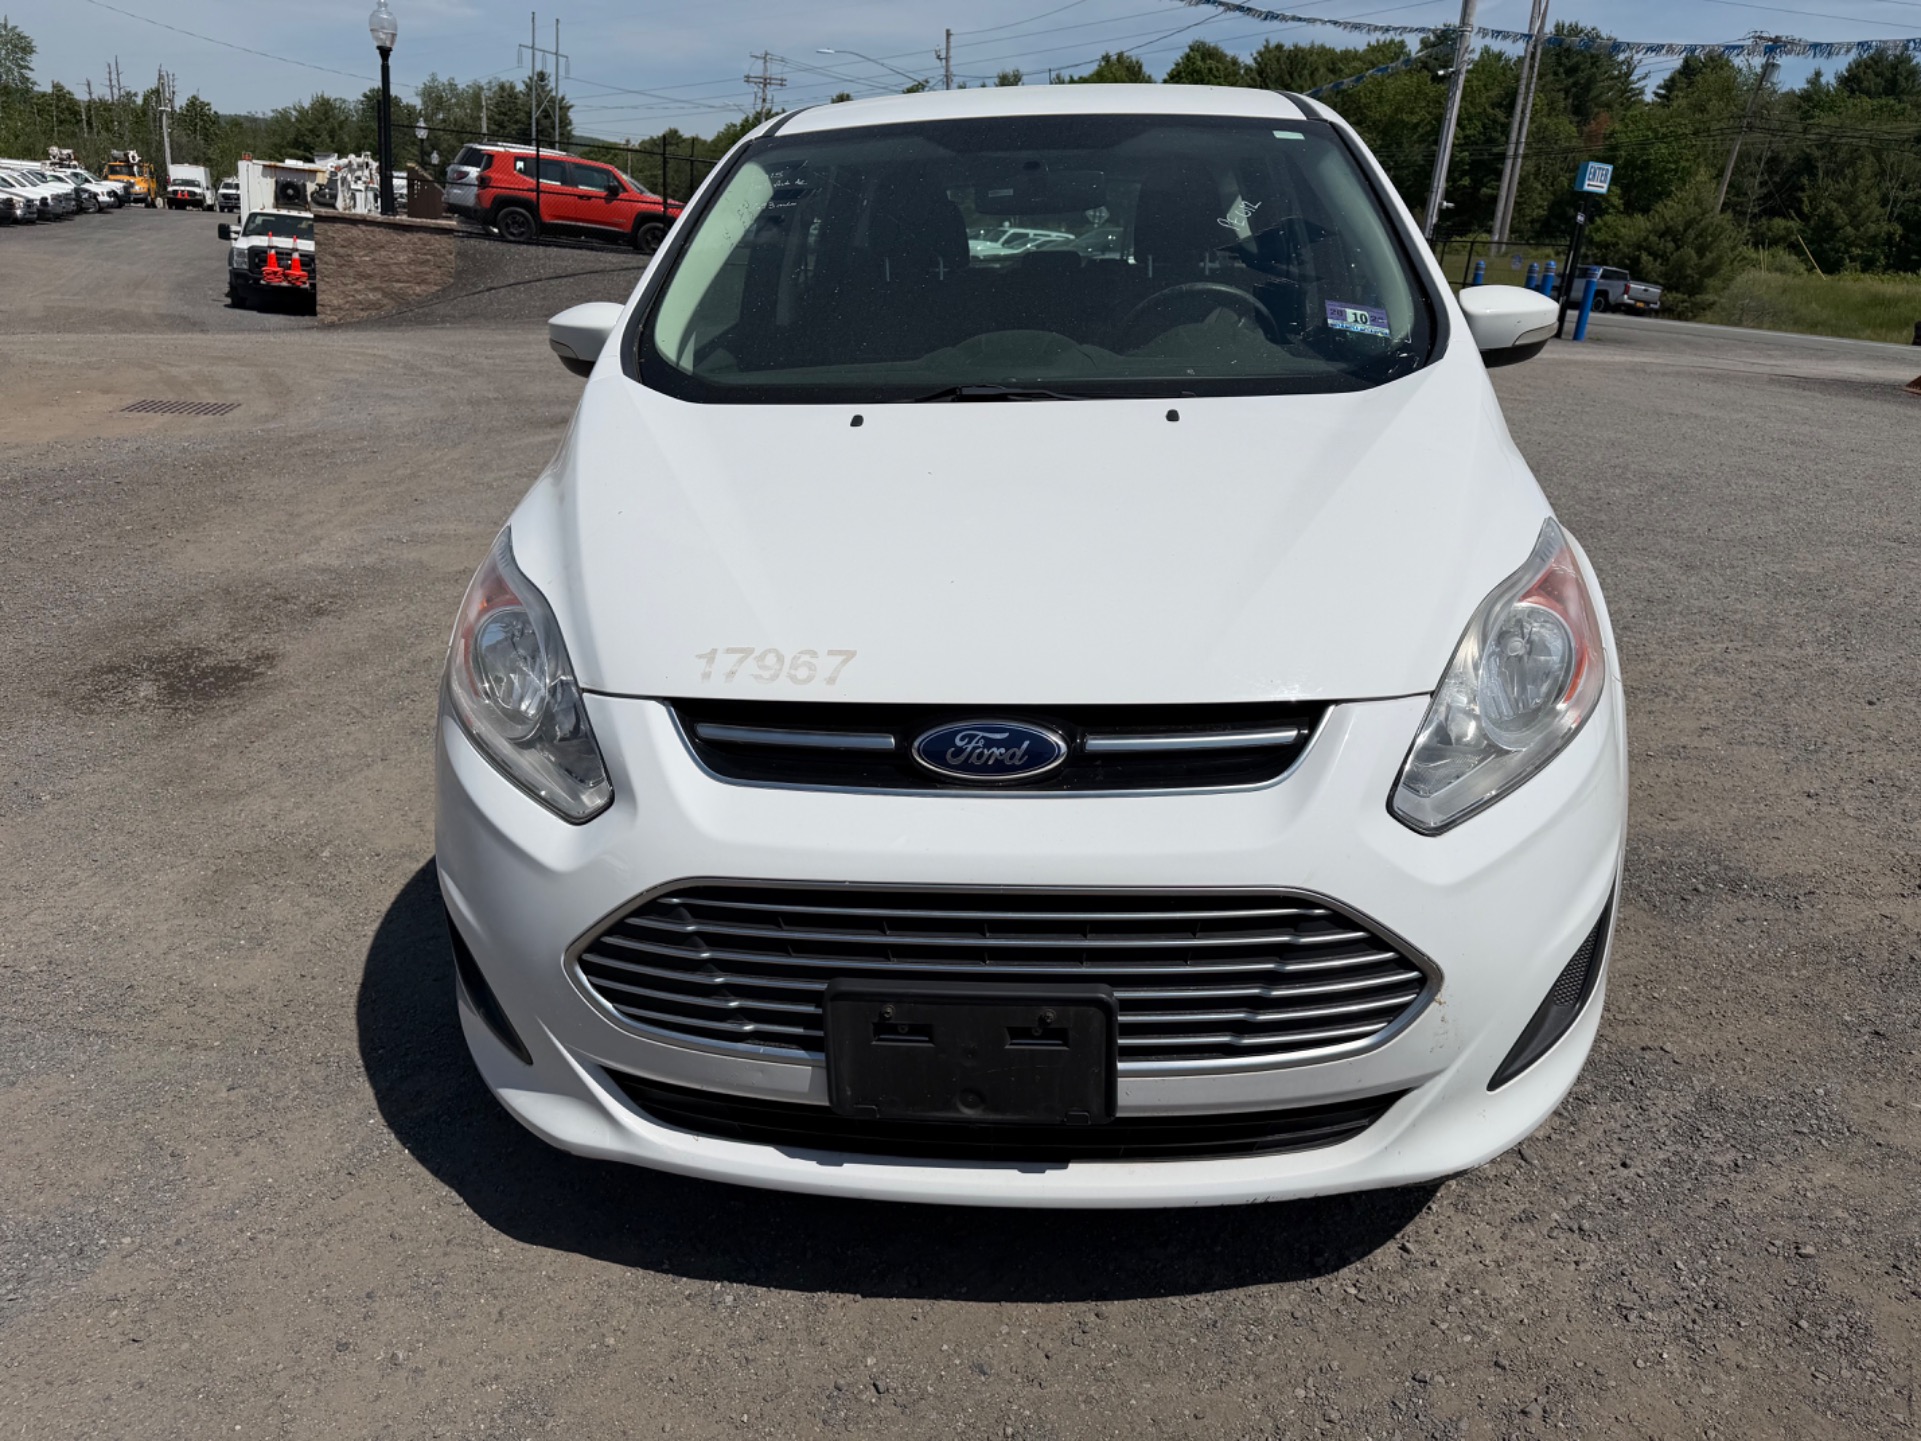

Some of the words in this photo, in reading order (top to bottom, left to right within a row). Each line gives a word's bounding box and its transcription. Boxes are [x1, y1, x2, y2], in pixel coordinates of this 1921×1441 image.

[1588, 165, 1609, 184] ENTER
[1352, 312, 1368, 324] 10
[695, 646, 858, 686] 17967
[945, 730, 1031, 766] Ford
